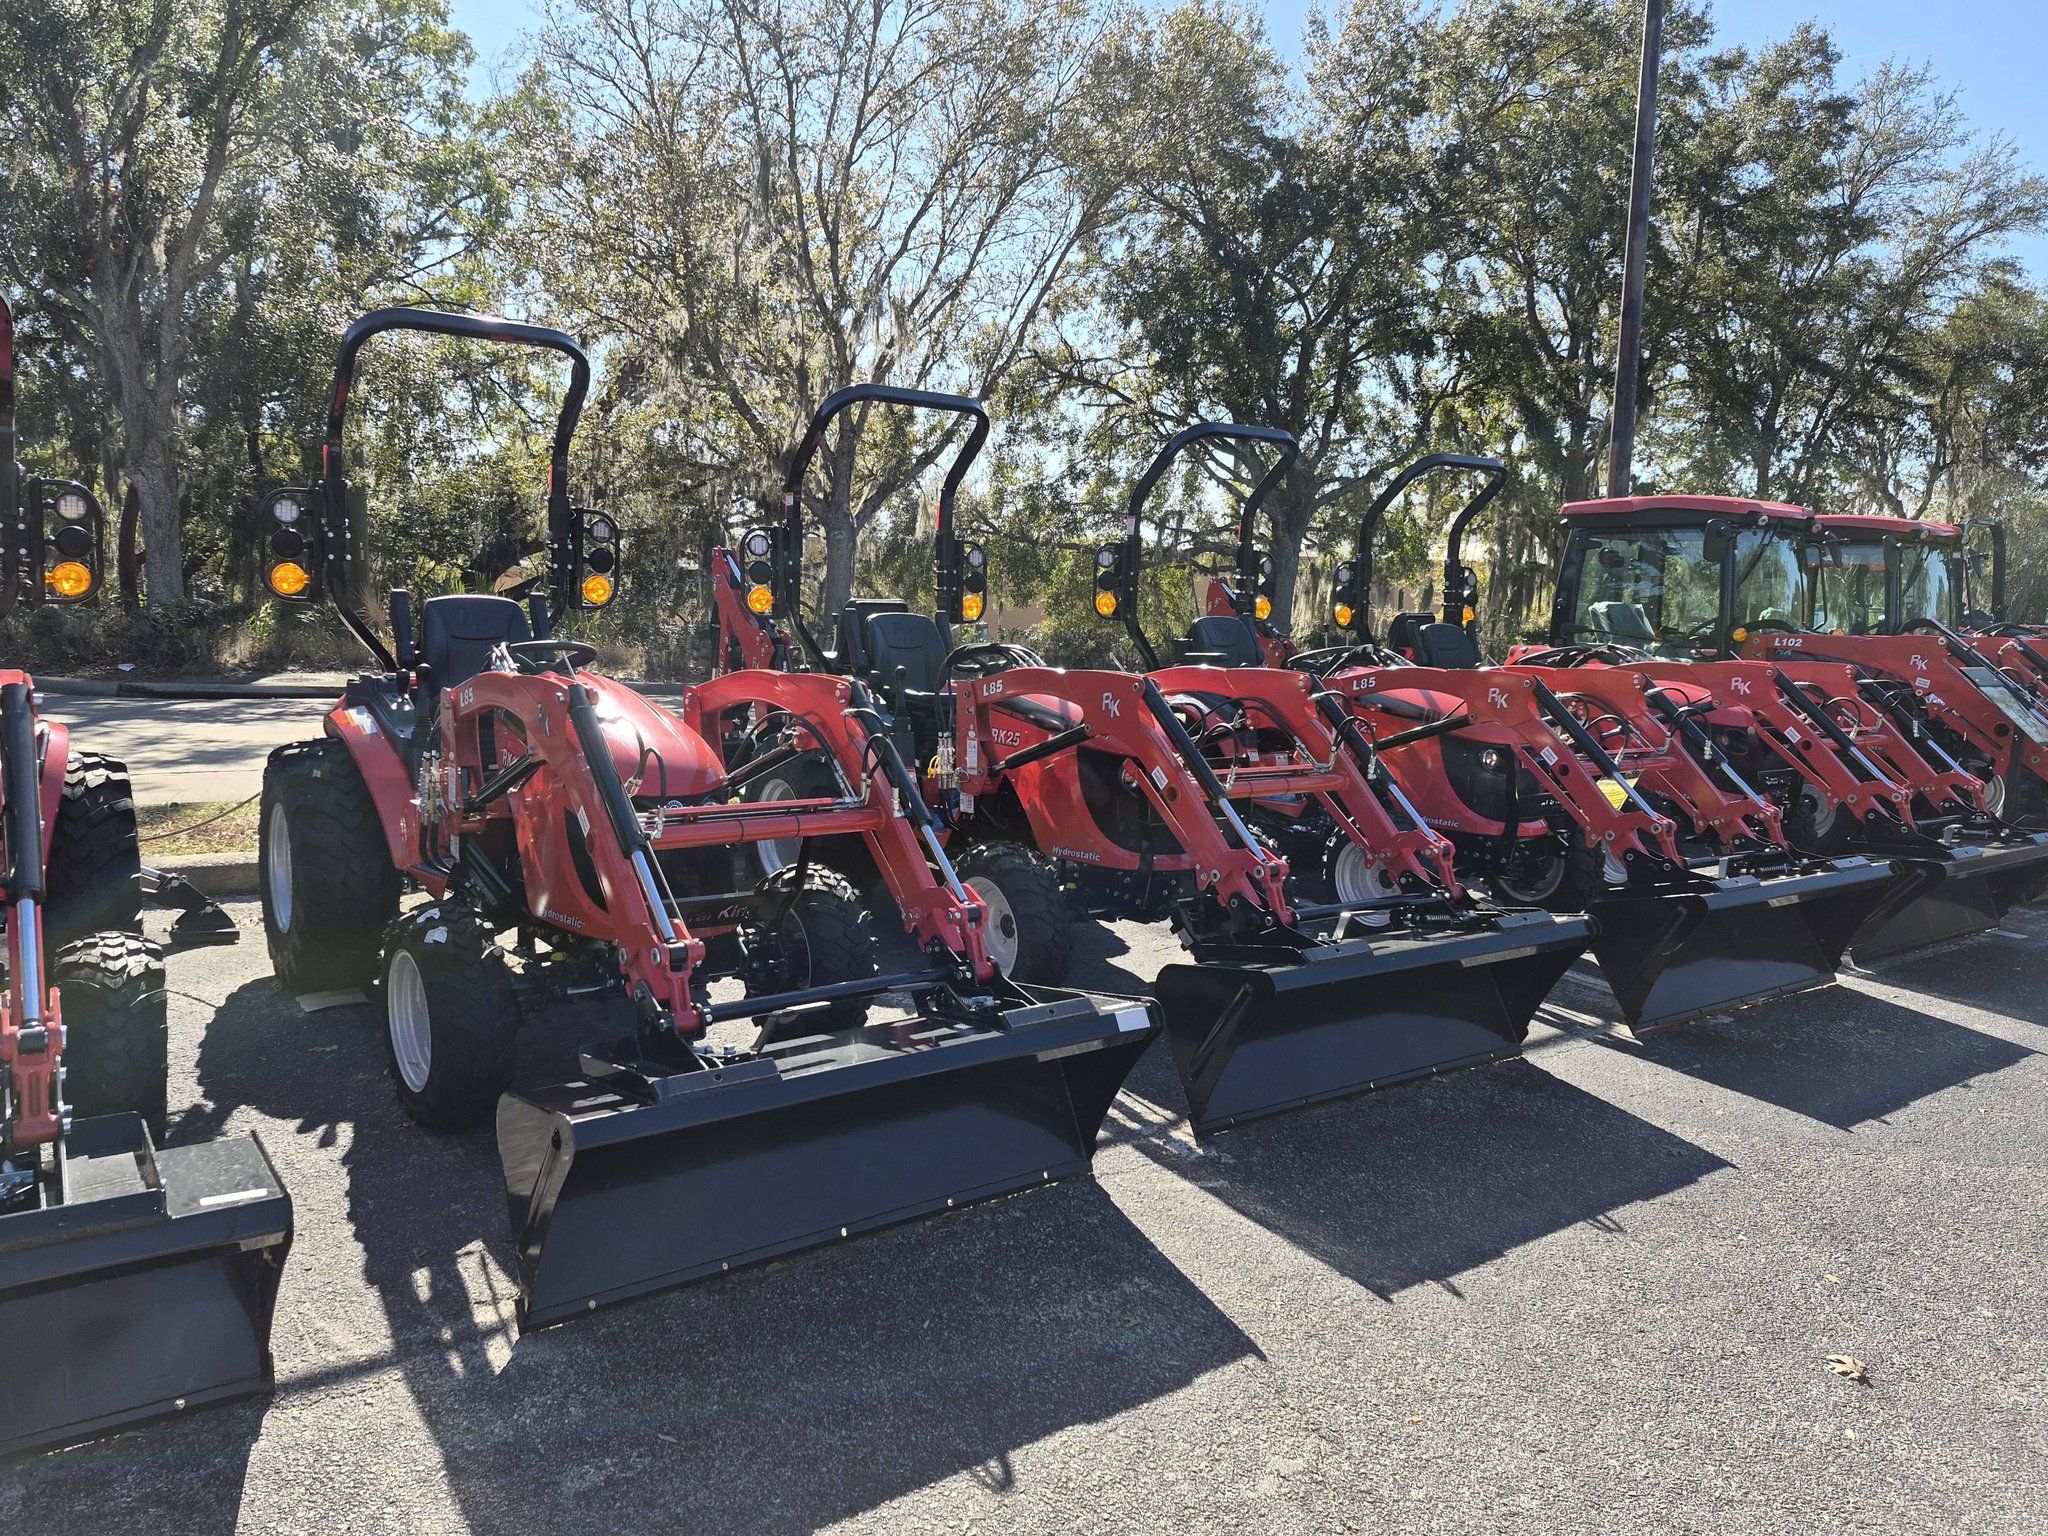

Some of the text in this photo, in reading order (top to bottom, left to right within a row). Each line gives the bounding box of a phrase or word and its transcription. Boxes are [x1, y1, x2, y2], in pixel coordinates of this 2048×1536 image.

[1774, 637, 1803, 647] L102
[1909, 654, 1929, 671] RK
[983, 679, 1003, 697] L85
[1352, 677, 1376, 691] L85
[1730, 677, 1752, 695] RK
[460, 686, 474, 708] L85
[1102, 691, 1121, 718] RK
[1488, 687, 1509, 709] RK
[992, 727, 1021, 747] RK25
[1421, 815, 1460, 828] drostatic
[1052, 844, 1101, 861] Hydrostatic
[540, 907, 583, 929] ydrostatic
